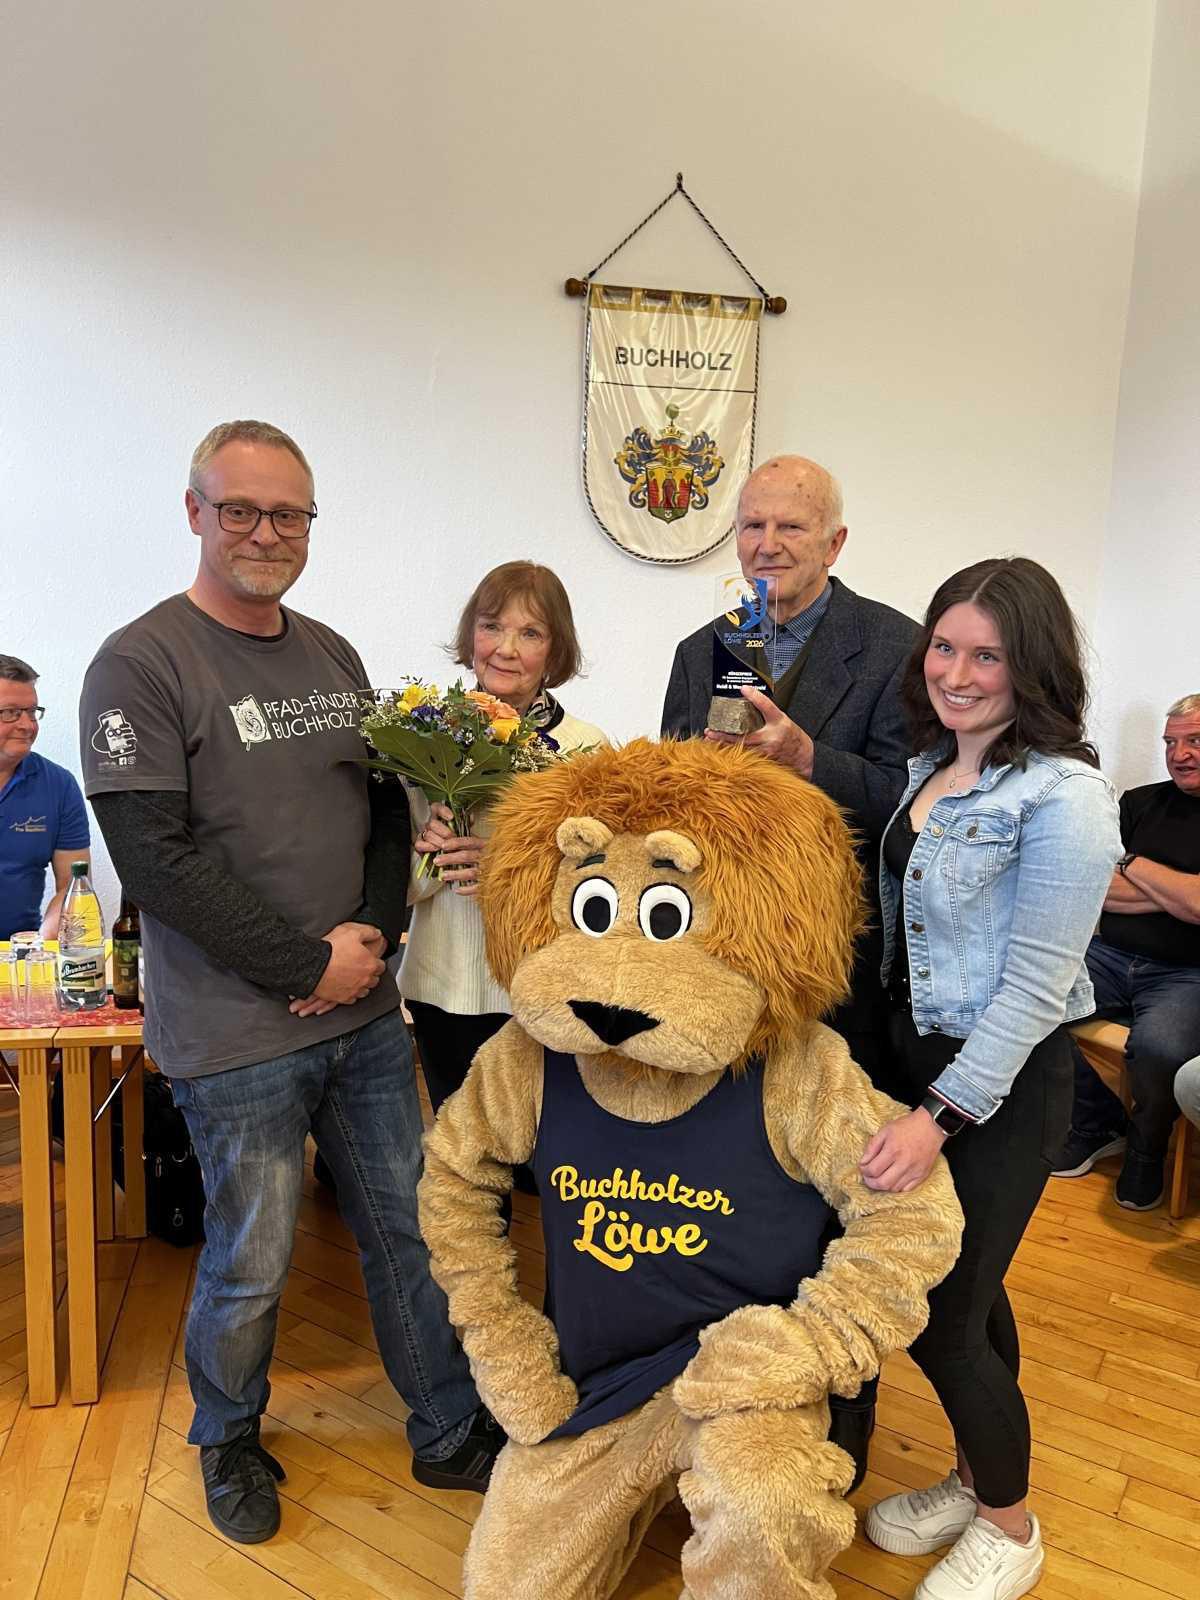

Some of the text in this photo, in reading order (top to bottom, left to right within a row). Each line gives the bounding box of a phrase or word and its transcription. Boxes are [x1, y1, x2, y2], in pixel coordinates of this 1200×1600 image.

[615, 346, 733, 371] BUCHHOLZ
[272, 711, 356, 739] BUCHHOLZ
[551, 1165, 735, 1216] Buchholzer
[573, 1200, 708, 1272] Löwe
